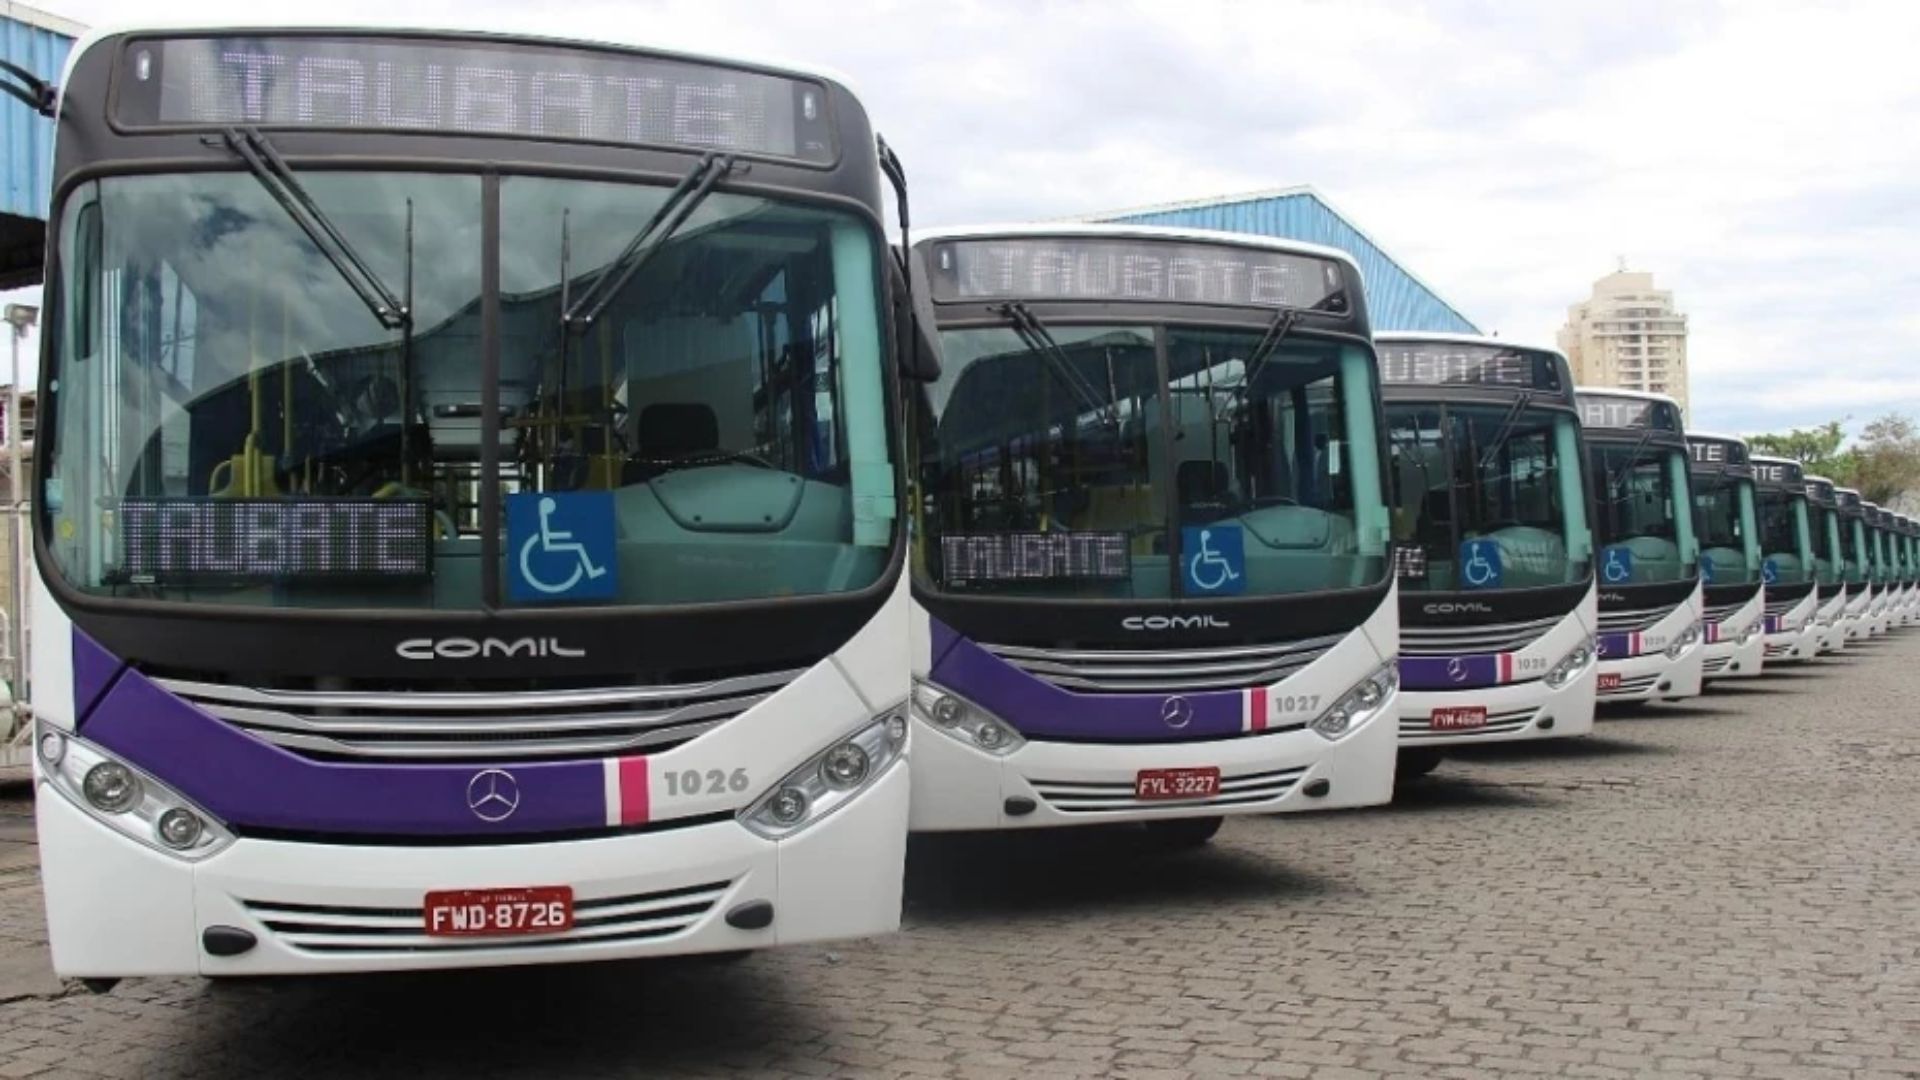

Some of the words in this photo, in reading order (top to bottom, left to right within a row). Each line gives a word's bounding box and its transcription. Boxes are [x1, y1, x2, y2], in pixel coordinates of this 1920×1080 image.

[223, 52, 737, 145] TAUBATE
[989, 247, 1287, 303] TAUBATE
[1686, 443, 1723, 461] TE
[120, 502, 416, 571] TAUBATE
[1423, 602, 1492, 614] COMIL
[1122, 615, 1230, 630] COMIL
[396, 637, 586, 659] COMIL
[1276, 695, 1321, 713] 1027
[664, 767, 750, 796] 1026
[1139, 775, 1215, 795] FYL-3227
[432, 902, 566, 931] FWD-8726
